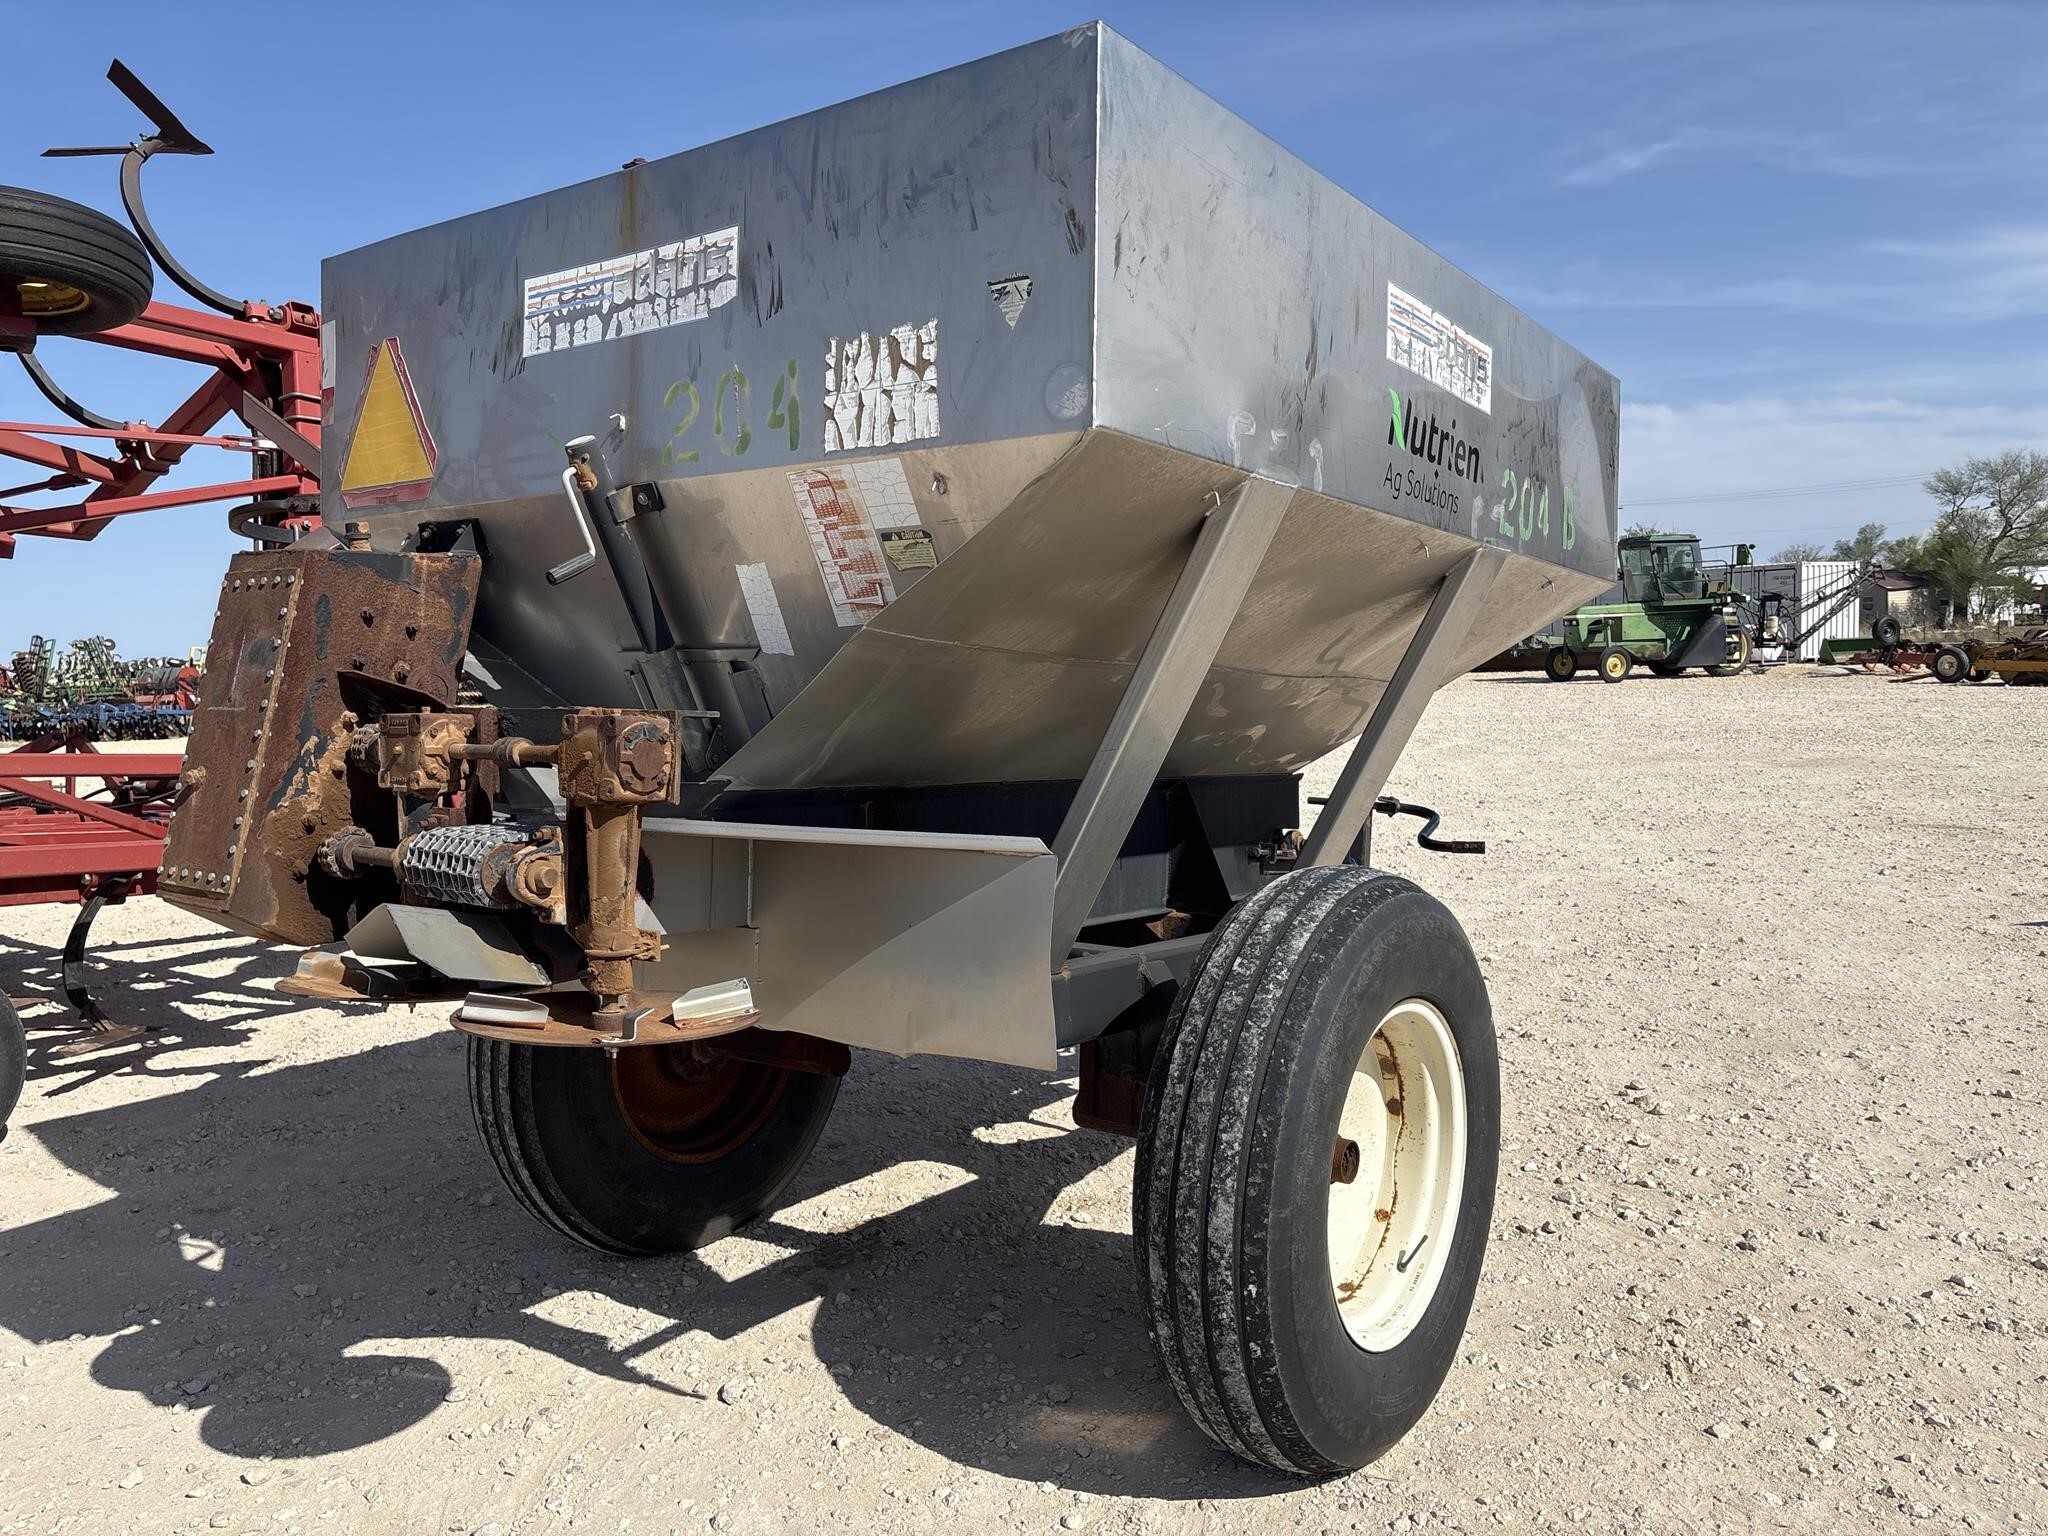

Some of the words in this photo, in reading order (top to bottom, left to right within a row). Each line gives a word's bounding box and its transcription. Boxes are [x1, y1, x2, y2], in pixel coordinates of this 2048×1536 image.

[662, 358, 800, 465] 204
[1387, 388, 1483, 484] Nutrien
[1383, 462, 1402, 499] Ag
[1405, 468, 1459, 514] Solutions
[1499, 468, 1549, 541] 204
[1562, 486, 1576, 550] B
